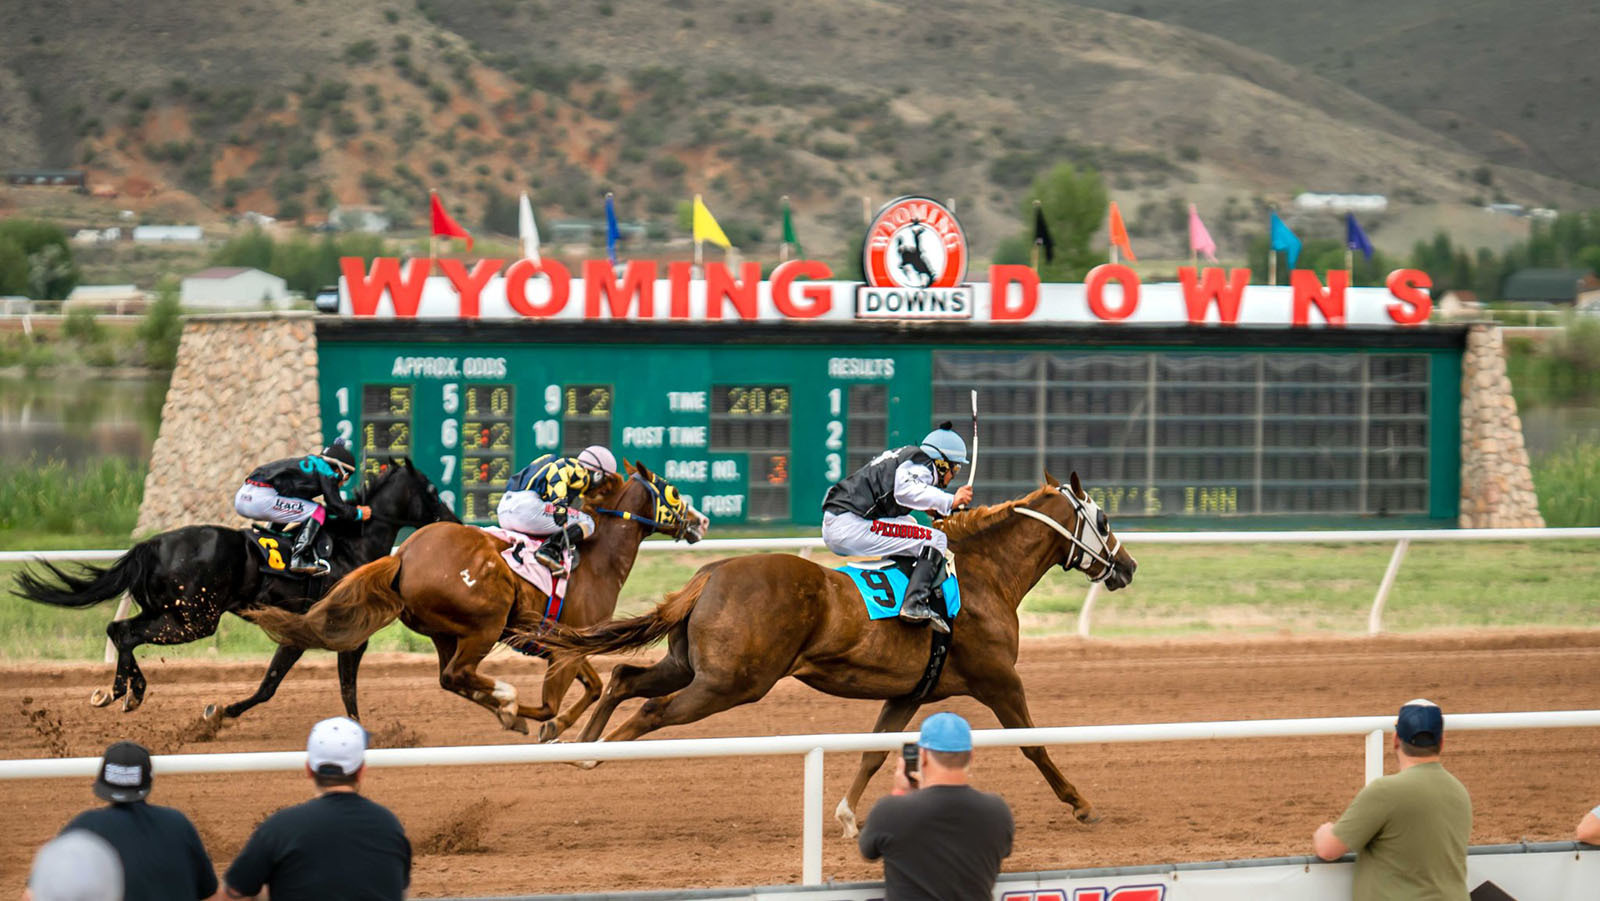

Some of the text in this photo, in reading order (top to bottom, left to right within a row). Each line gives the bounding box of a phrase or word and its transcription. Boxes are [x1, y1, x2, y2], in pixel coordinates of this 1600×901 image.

[340, 257, 834, 319] WYOMING
[866, 291, 965, 312] DOWNS
[989, 264, 1433, 326] DOWNS
[391, 356, 507, 379] APPROX. ODDS
[827, 357, 895, 379] RESULTS
[336, 387, 349, 416] 1
[390, 387, 410, 416] 5
[442, 383, 459, 414] 5
[544, 384, 561, 415] 9
[667, 391, 707, 413] TIME
[727, 387, 789, 416] 209
[828, 388, 841, 416] 1
[441, 418, 458, 449] 6
[532, 419, 560, 449] 10
[622, 426, 707, 448] POST TIME
[825, 420, 843, 449] 2
[440, 455, 457, 484] 7
[665, 459, 740, 482] RACE NO.
[768, 456, 788, 483] 3
[825, 453, 842, 482] 3
[701, 494, 744, 517] POST
[870, 519, 932, 541] SPEEDHORSE
[860, 571, 896, 608] 9
